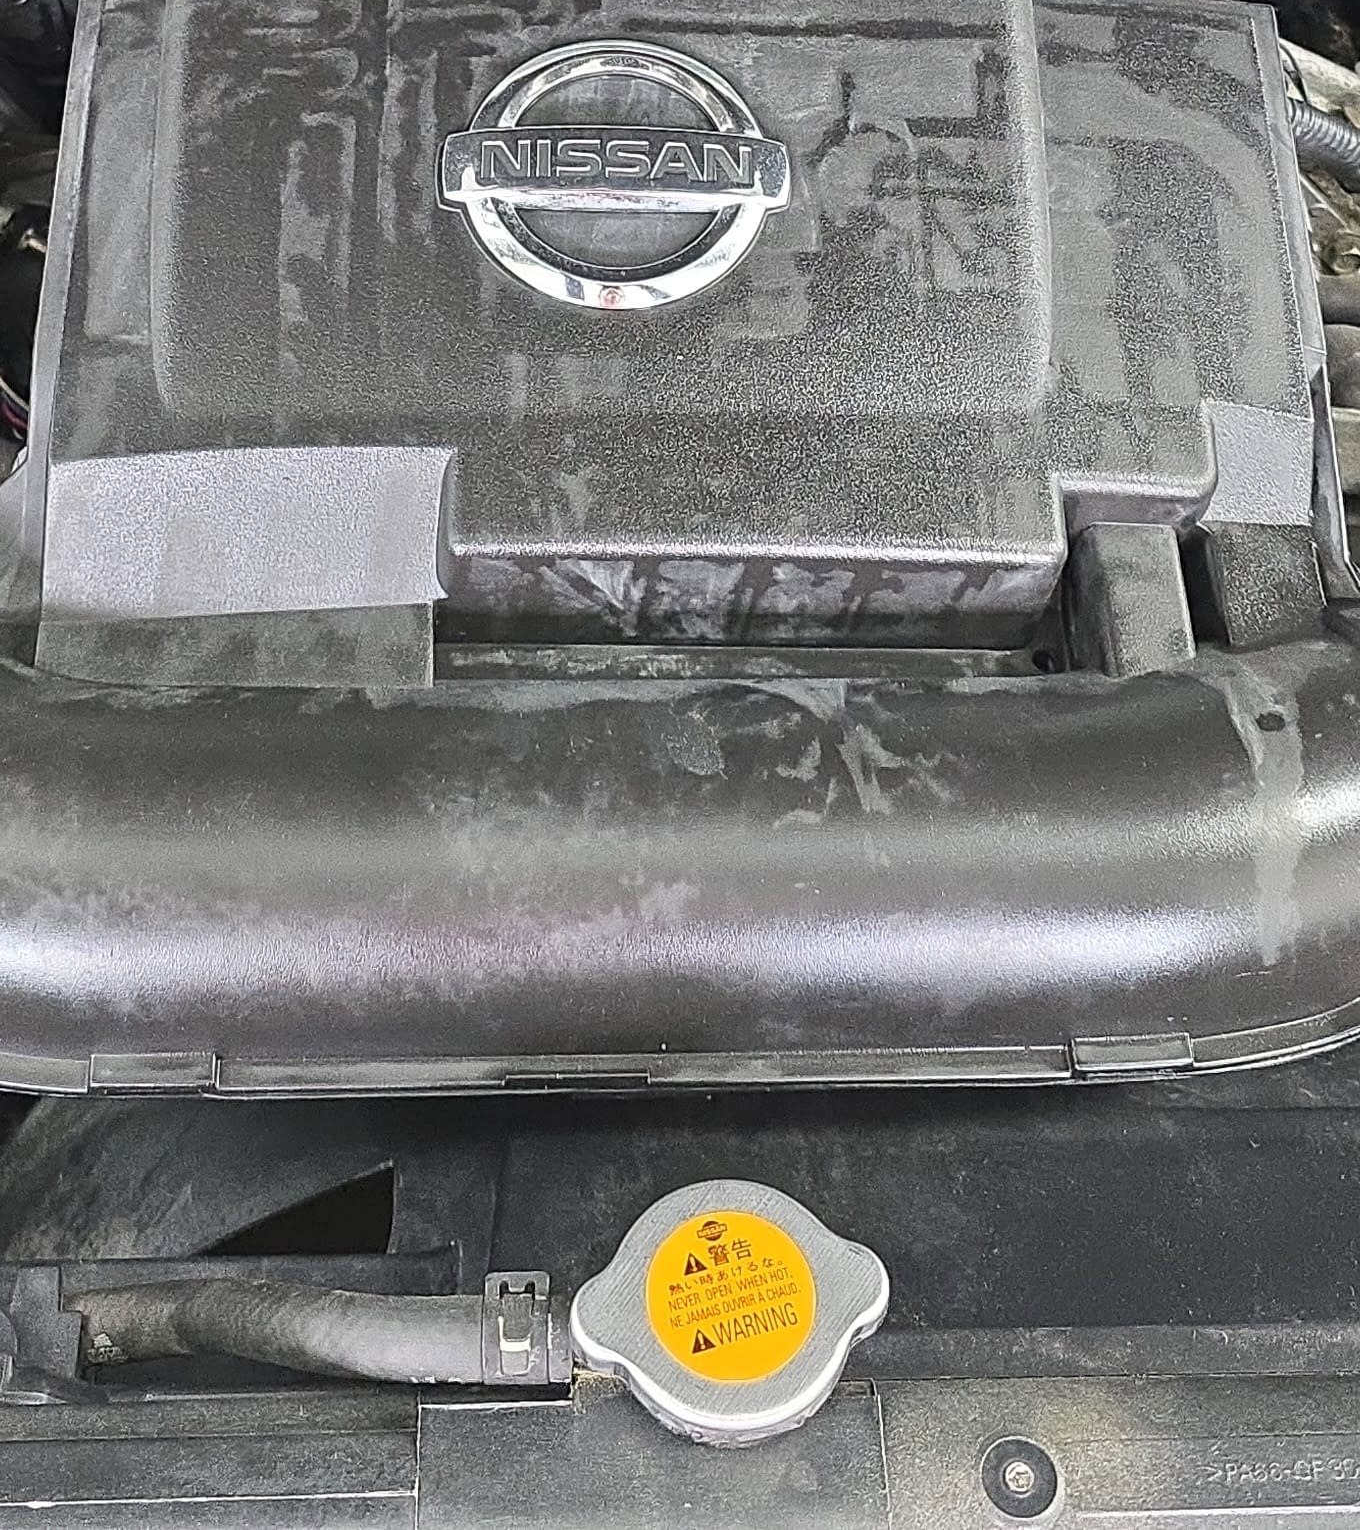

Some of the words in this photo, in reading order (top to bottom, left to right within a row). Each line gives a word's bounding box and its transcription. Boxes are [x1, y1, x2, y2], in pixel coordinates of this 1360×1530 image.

[480, 138, 752, 184] NISSAN
[698, 1224, 727, 1238] NISSAN
[708, 1238, 752, 1266] 警告
[668, 1292, 701, 1312] NEVER
[705, 1284, 732, 1301] OPEN
[736, 1274, 768, 1292] WHEN
[670, 1316, 682, 1329] NE
[686, 1304, 721, 1325] JAMAIS
[723, 1294, 757, 1313] OUVRIR
[712, 1302, 798, 1345] WARNING
